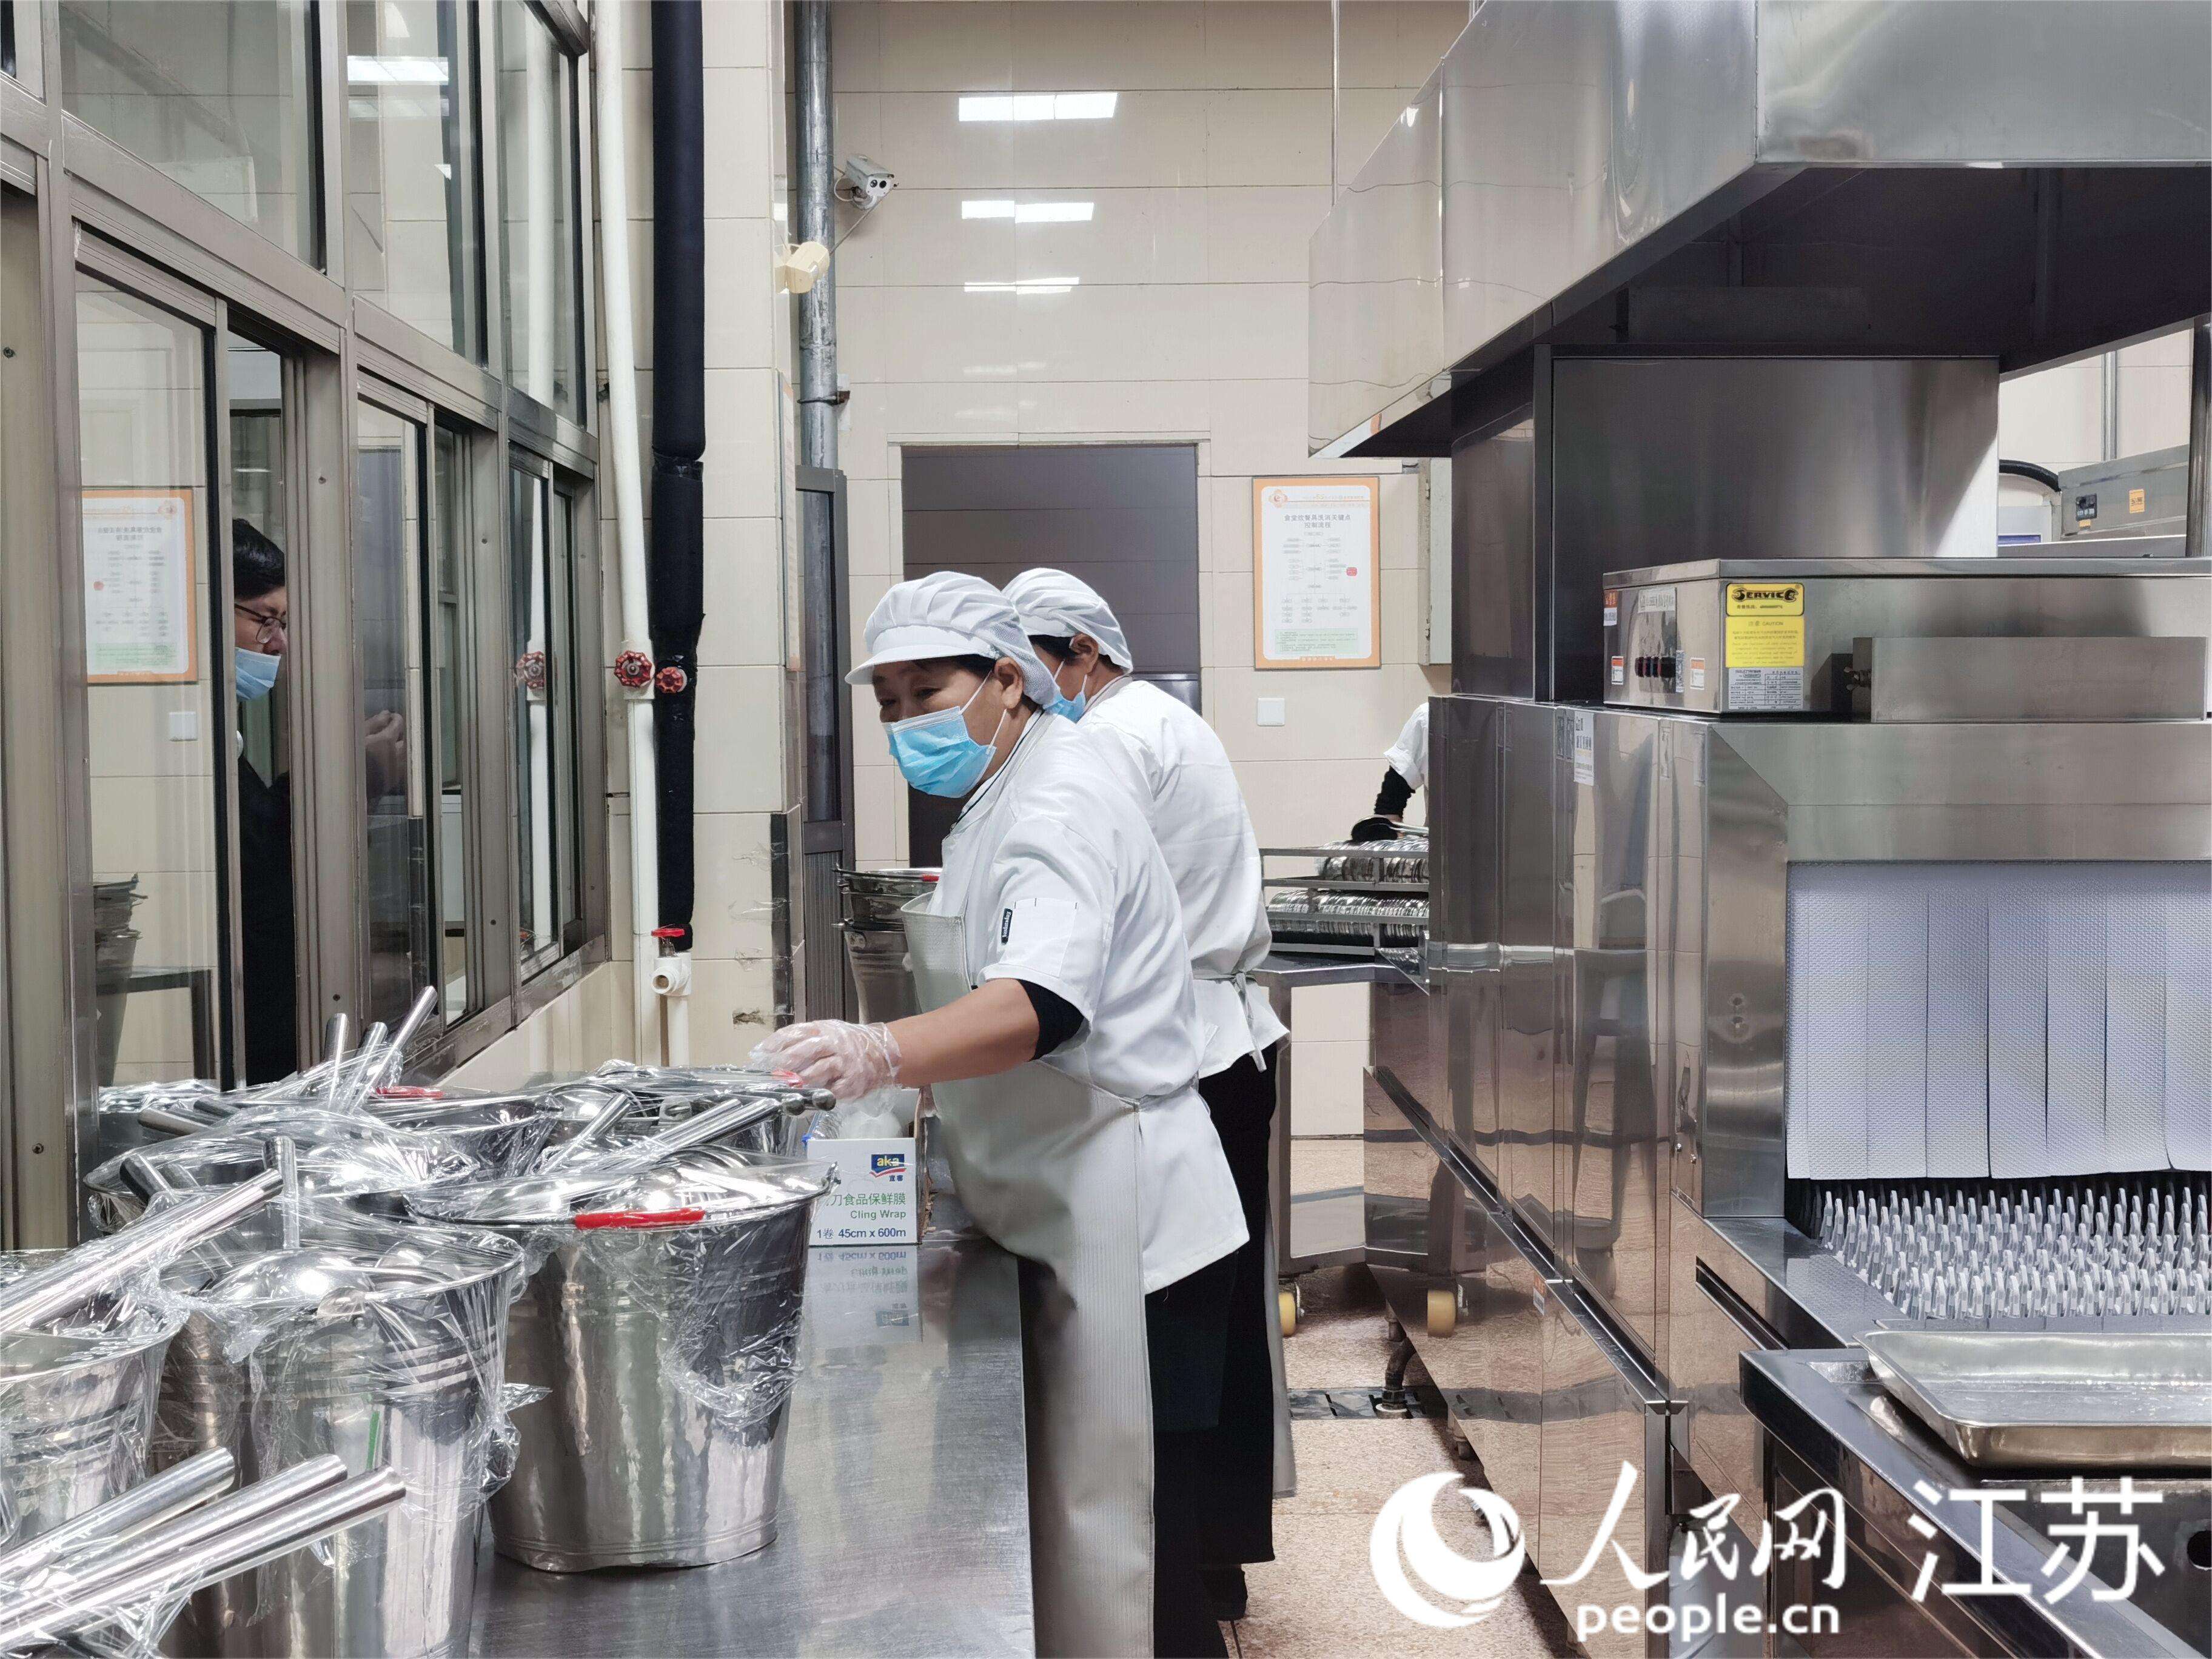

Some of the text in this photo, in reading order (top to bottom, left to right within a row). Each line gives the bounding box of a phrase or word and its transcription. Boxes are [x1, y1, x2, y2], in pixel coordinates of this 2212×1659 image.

[1732, 588, 1798, 602] SERVICE
[850, 1210, 907, 1220] Cling Wrap
[816, 1228, 834, 1239] 1卷
[838, 1228, 866, 1238] 45cm
[877, 1228, 906, 1238] 600m
